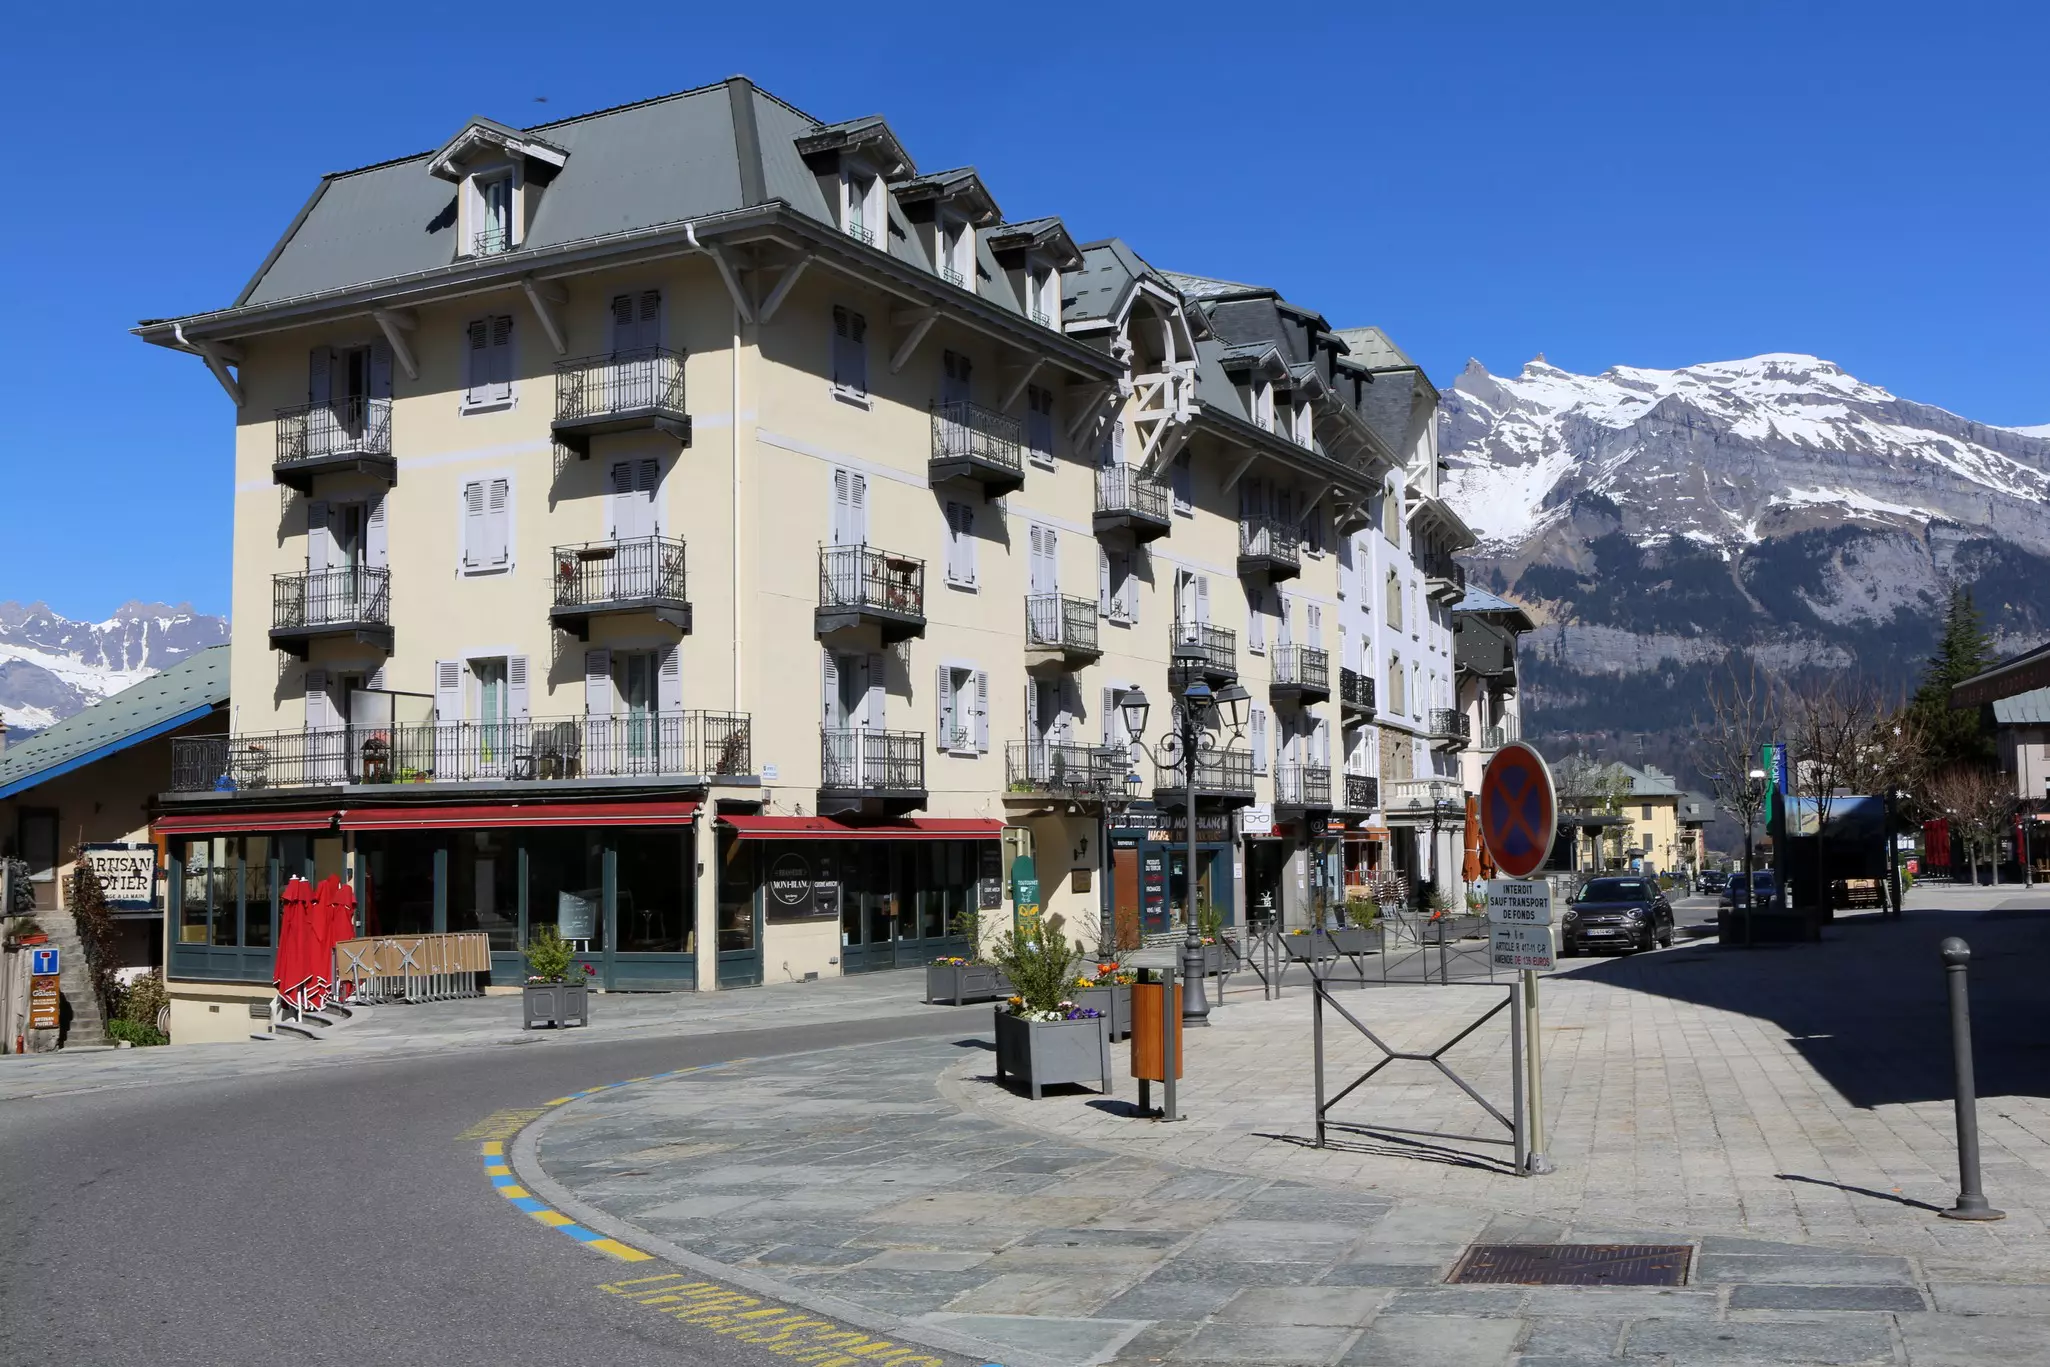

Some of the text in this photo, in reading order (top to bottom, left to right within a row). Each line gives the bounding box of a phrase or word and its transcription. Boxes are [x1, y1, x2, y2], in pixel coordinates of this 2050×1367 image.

[1160, 816, 1171, 829] DU
[1174, 815, 1221, 830] MO-BLANC
[87, 857, 152, 872] ARTISAN
[98, 875, 148, 890] OTIER
[1503, 884, 1533, 895] INTERDIT
[1490, 896, 1548, 908] SAUF TRANSPORT
[1503, 909, 1536, 920] DE FONDS
[1495, 941, 1515, 952] ARTICLE
[1515, 942, 1520, 952] R
[1494, 954, 1513, 965] AMENDE
[1514, 955, 1522, 965] DE
[1532, 956, 1550, 967] EUROS
